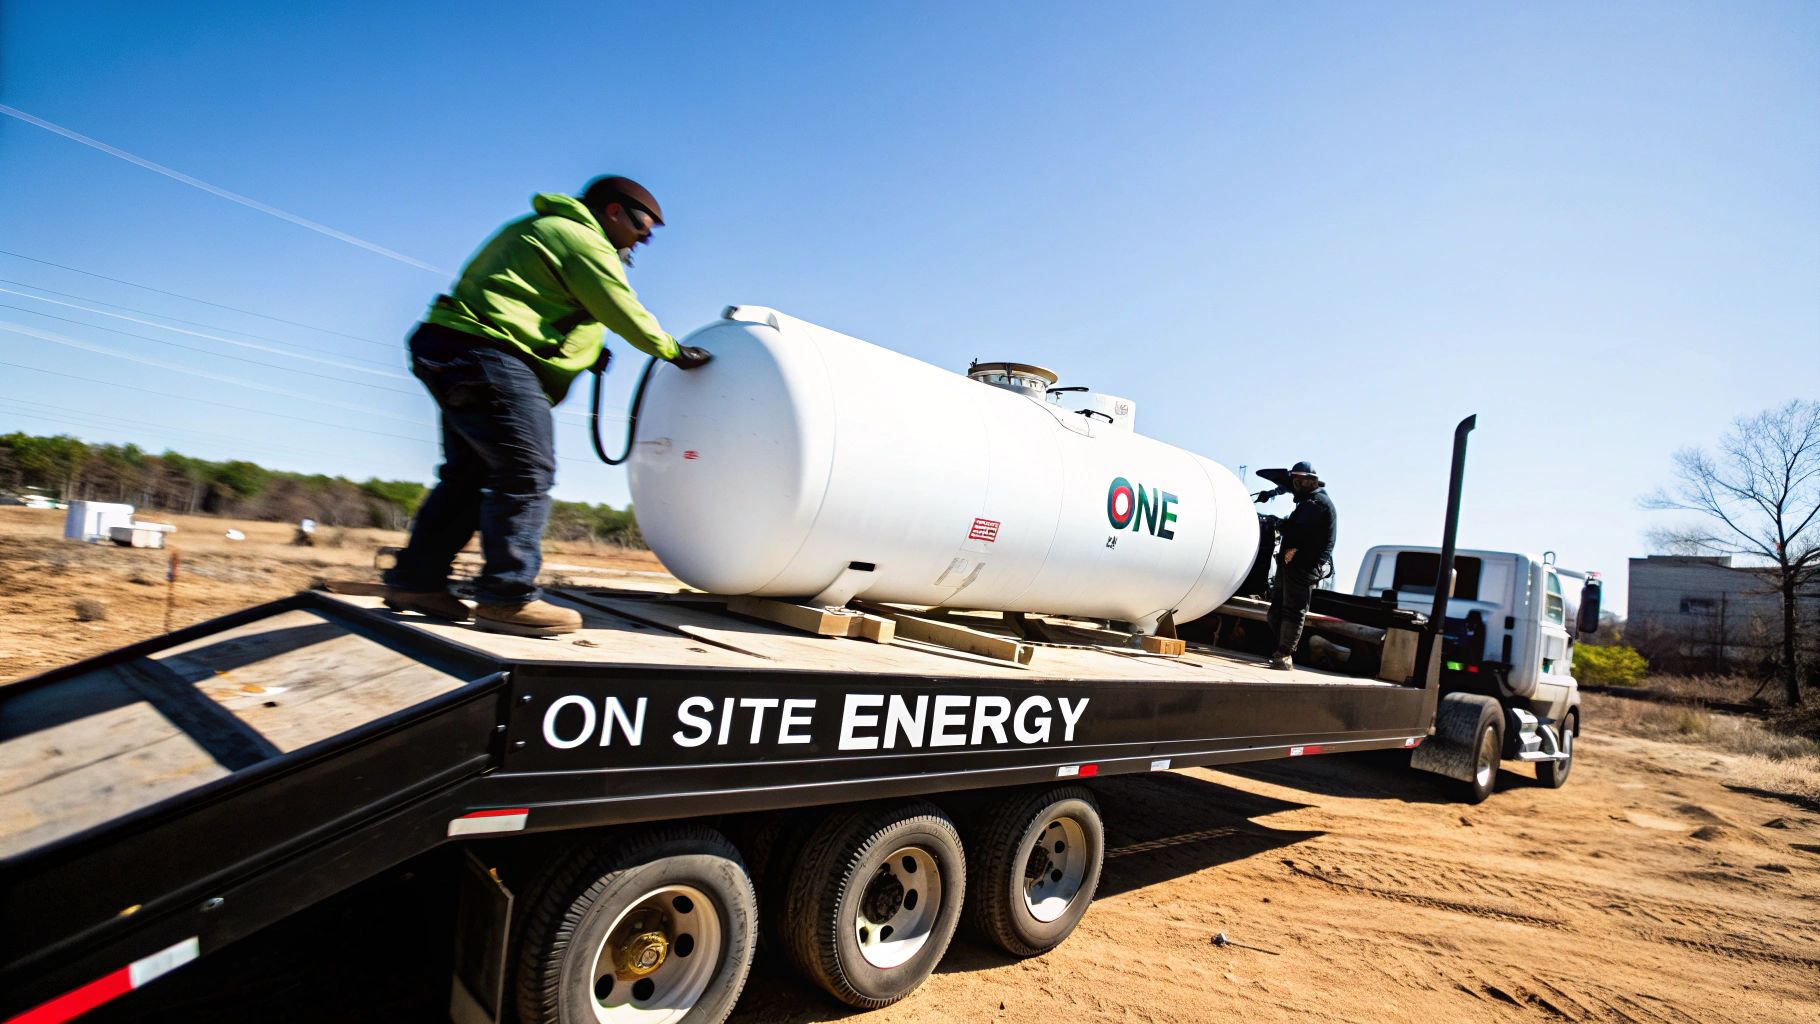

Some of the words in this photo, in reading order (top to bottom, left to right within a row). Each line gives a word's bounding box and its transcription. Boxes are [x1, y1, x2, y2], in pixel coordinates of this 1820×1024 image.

[1107, 476, 1179, 541] ONE
[542, 694, 648, 750] ON
[672, 695, 817, 748] SITE
[837, 693, 1091, 752] ENERGY
